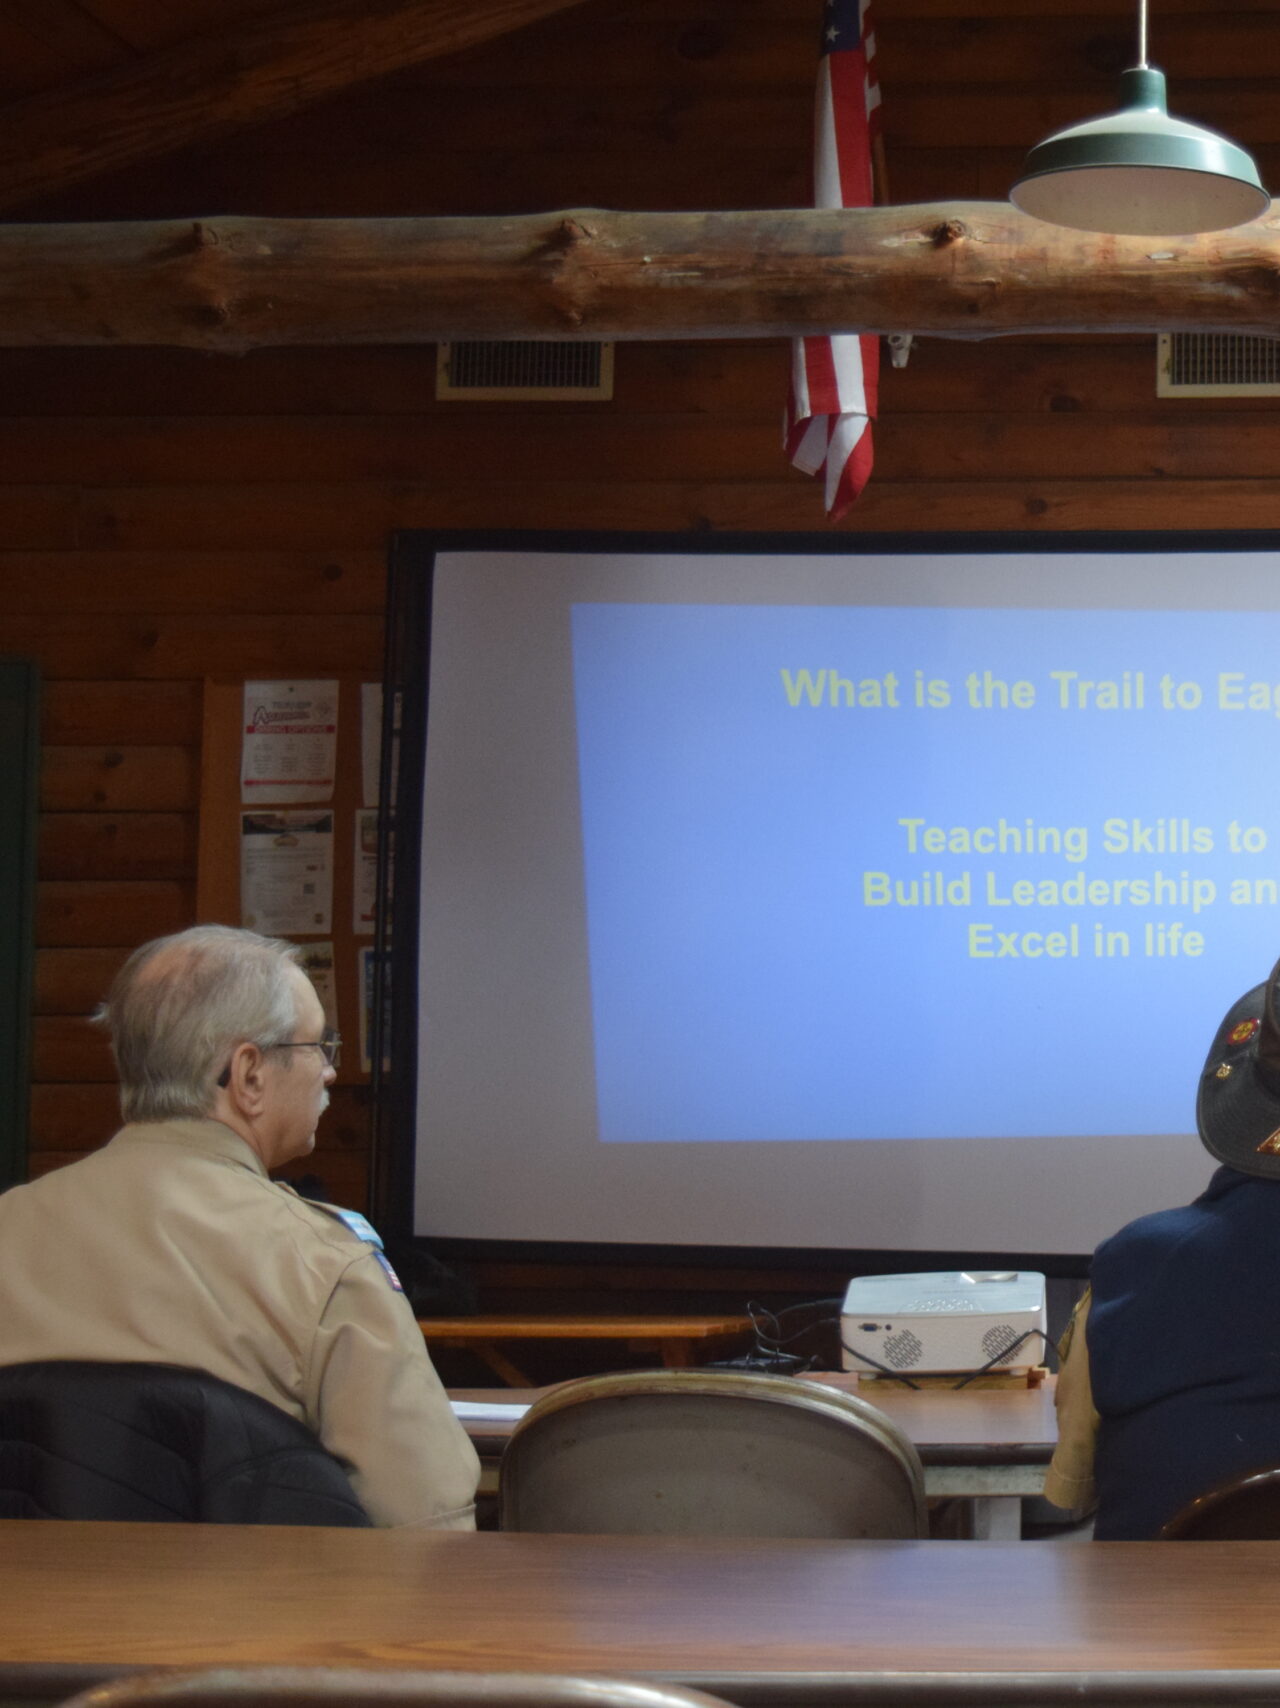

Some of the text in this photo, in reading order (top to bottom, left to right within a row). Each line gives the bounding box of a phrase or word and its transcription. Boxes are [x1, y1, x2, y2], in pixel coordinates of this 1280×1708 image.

[780, 668, 900, 708] What
[915, 670, 951, 708] is
[966, 670, 1036, 709] the
[1049, 671, 1145, 710] Trail
[1160, 673, 1203, 710] to
[898, 817, 1268, 863] Teaching Skills to
[863, 871, 971, 907] Build
[986, 870, 1217, 914] Leadership
[968, 922, 1205, 959] Excel in life
